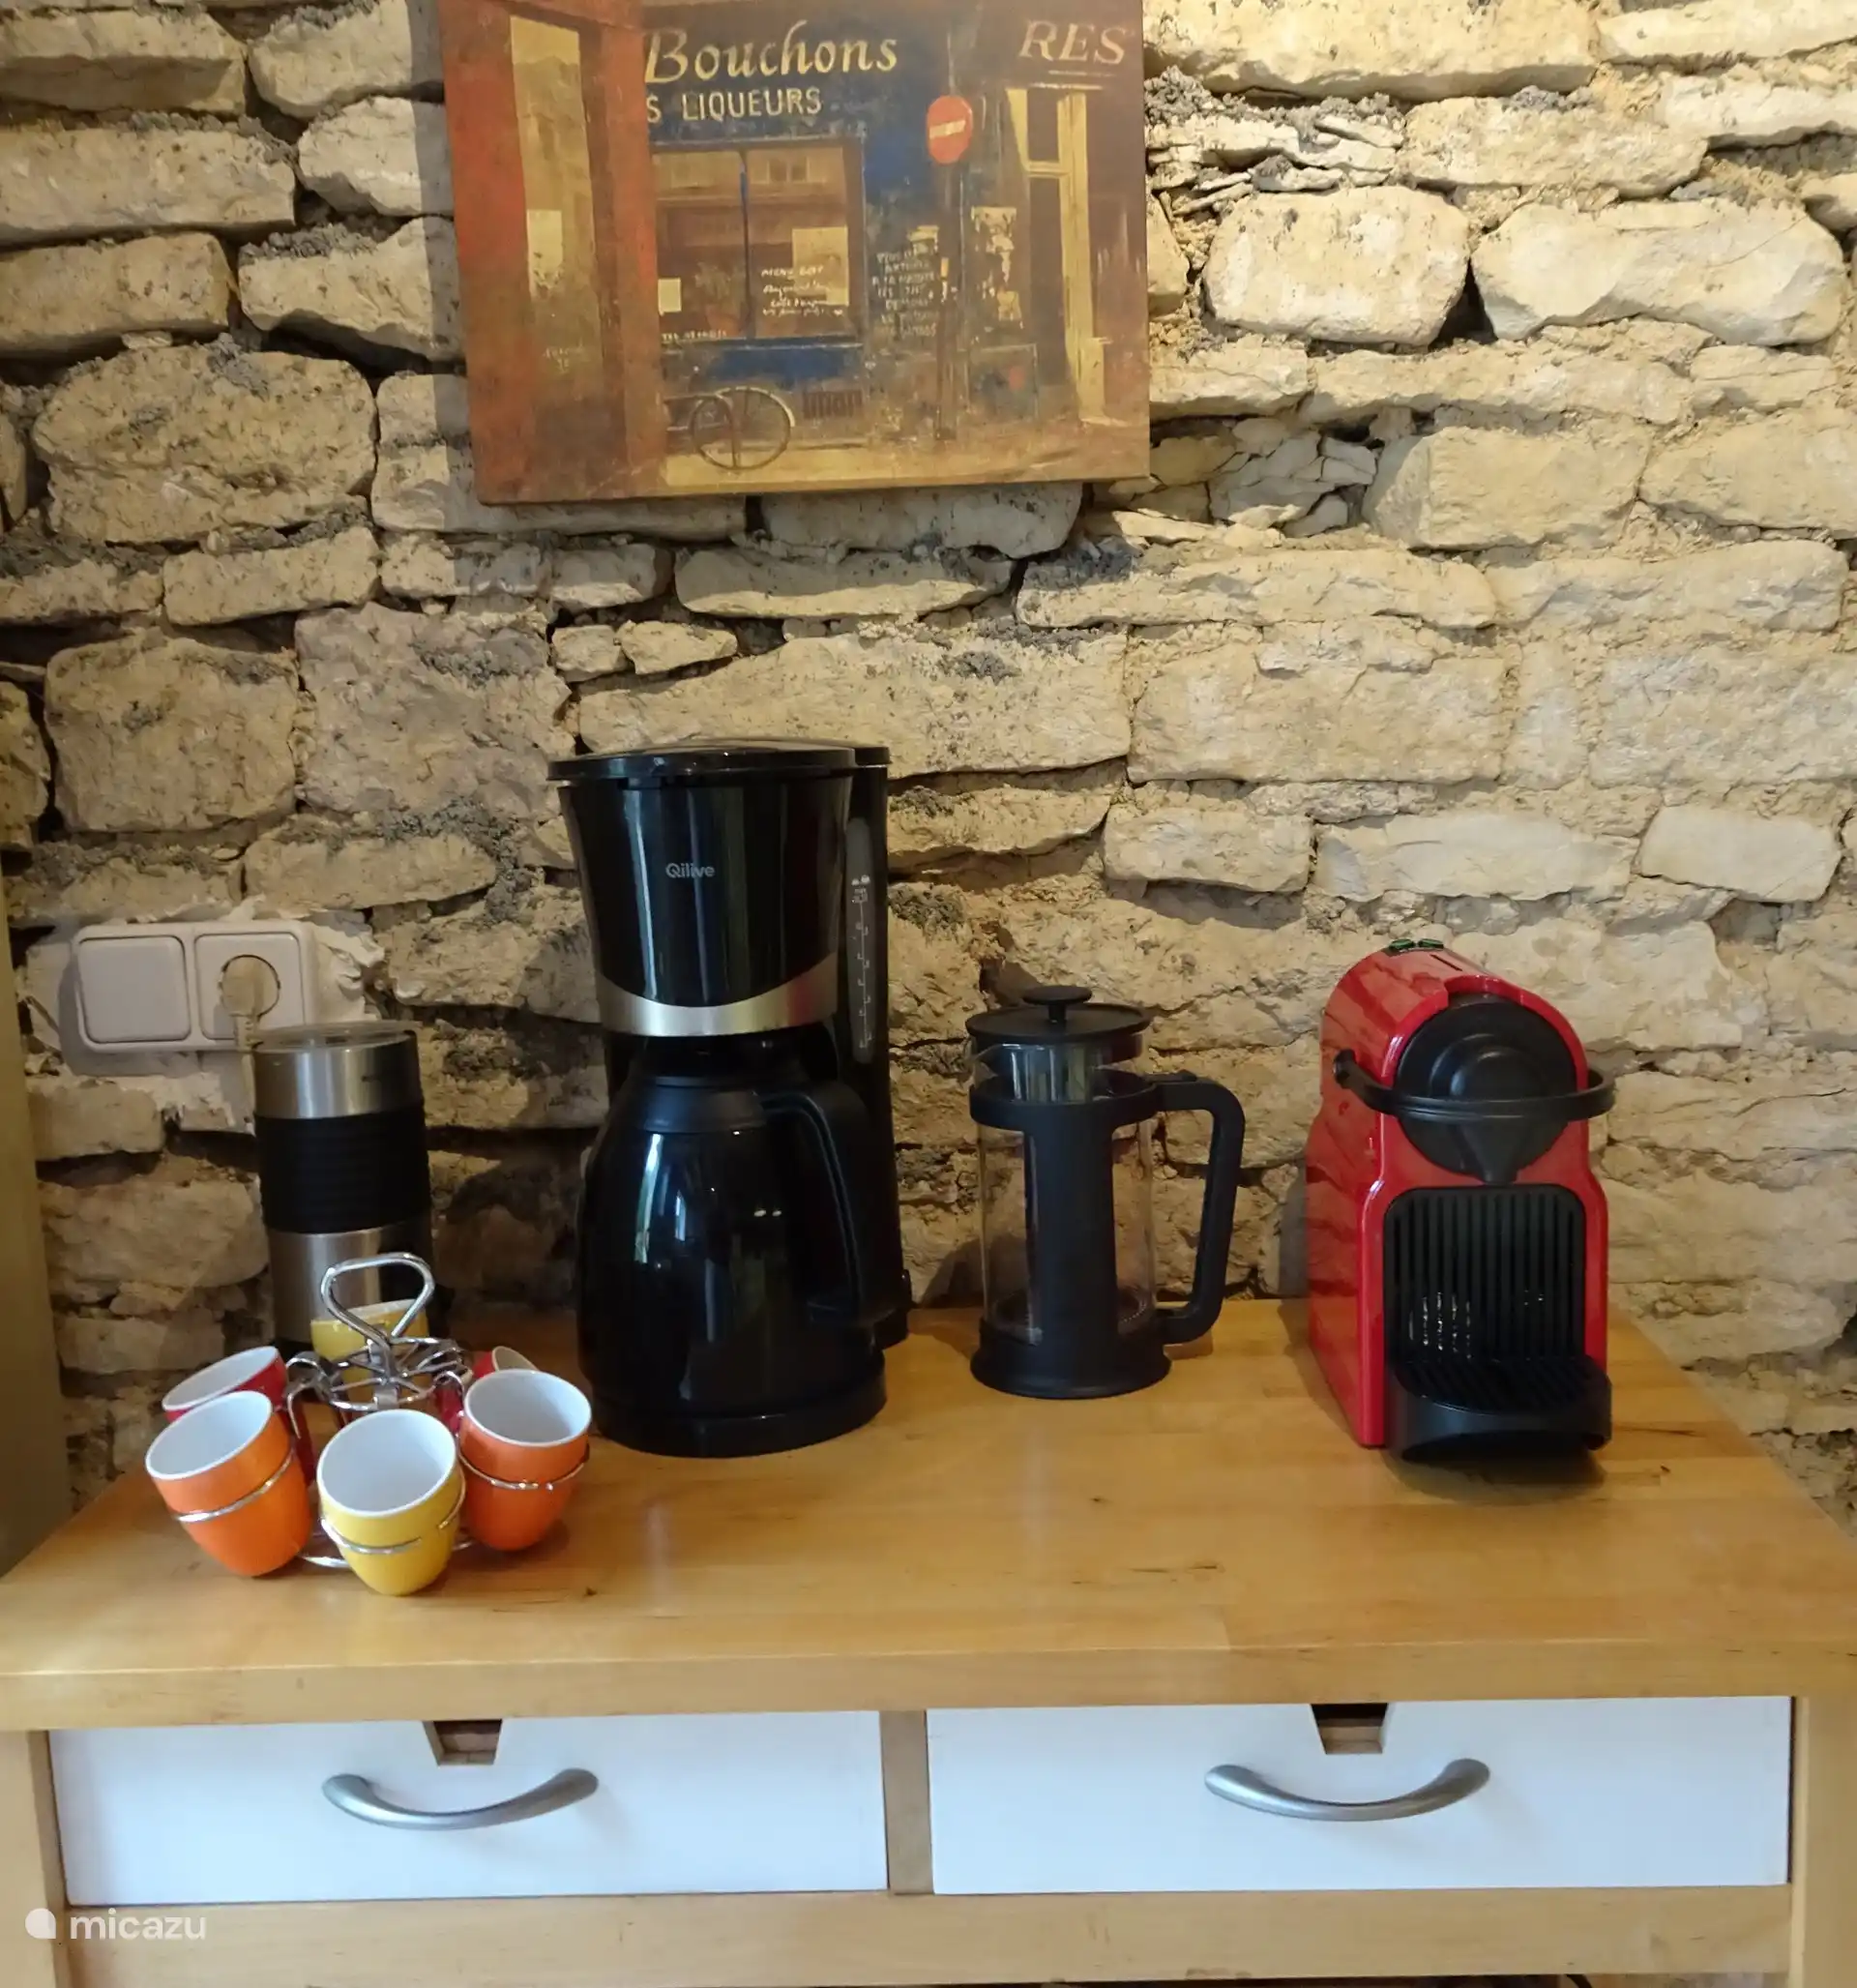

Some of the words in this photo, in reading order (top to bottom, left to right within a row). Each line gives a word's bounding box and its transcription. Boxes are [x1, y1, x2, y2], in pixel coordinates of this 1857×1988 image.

[645, 19, 898, 84] Bouchons
[1019, 20, 1127, 64] RES
[646, 94, 662, 124] S
[682, 88, 822, 120] LIQUEURS
[665, 863, 715, 878] Qilive
